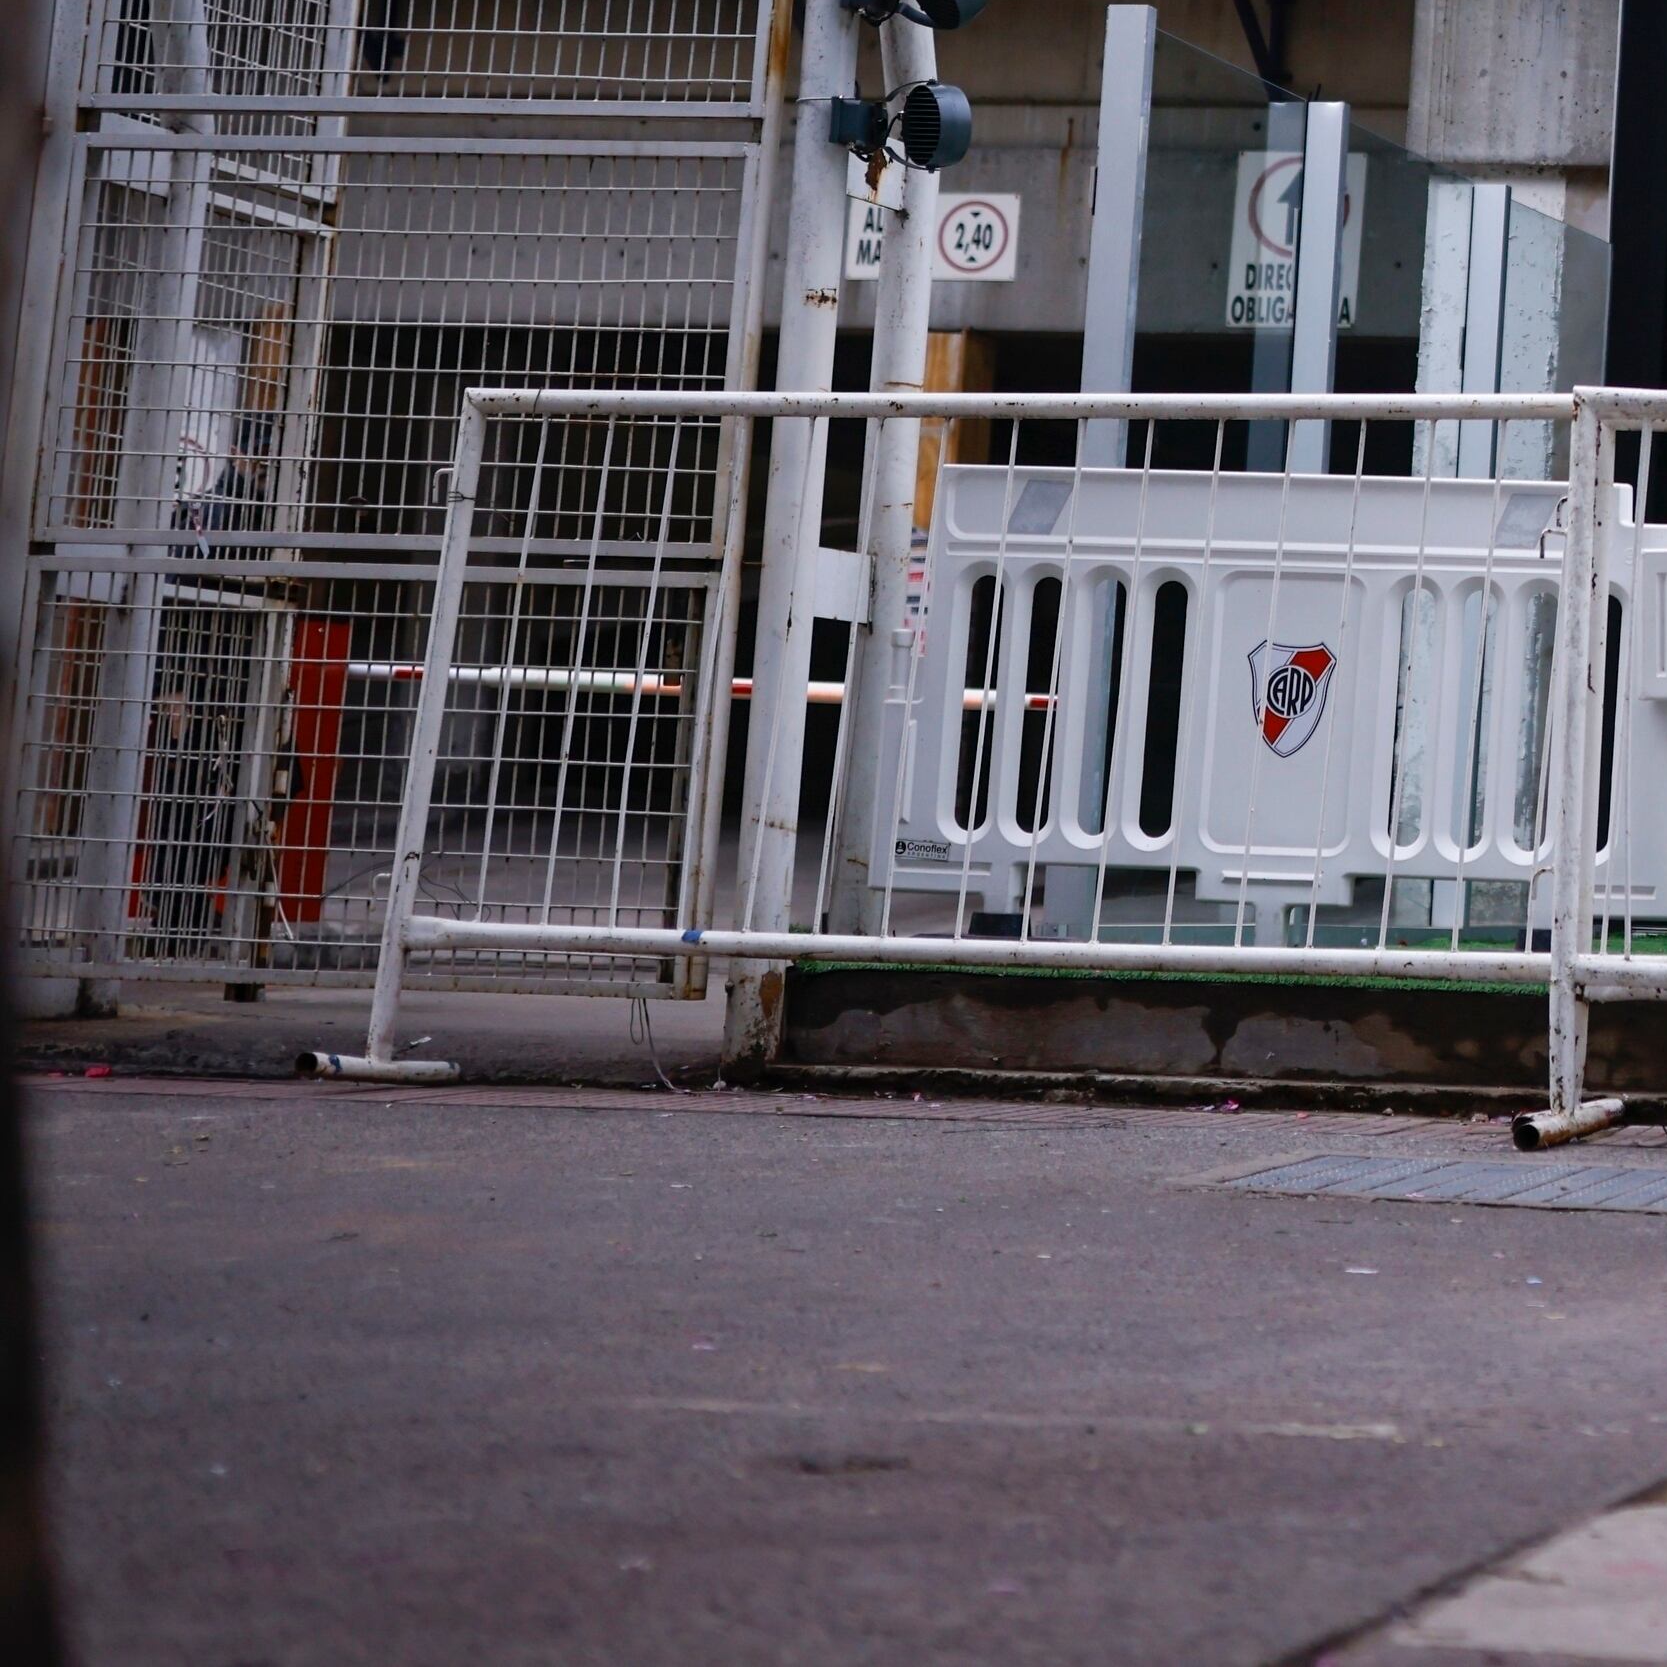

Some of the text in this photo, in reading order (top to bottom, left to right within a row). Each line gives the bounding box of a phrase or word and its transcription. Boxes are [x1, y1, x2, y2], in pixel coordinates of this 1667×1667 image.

[955, 222, 993, 254] 2,40
[1267, 666, 1314, 717] CARP
[907, 841, 948, 854] Conoflex
